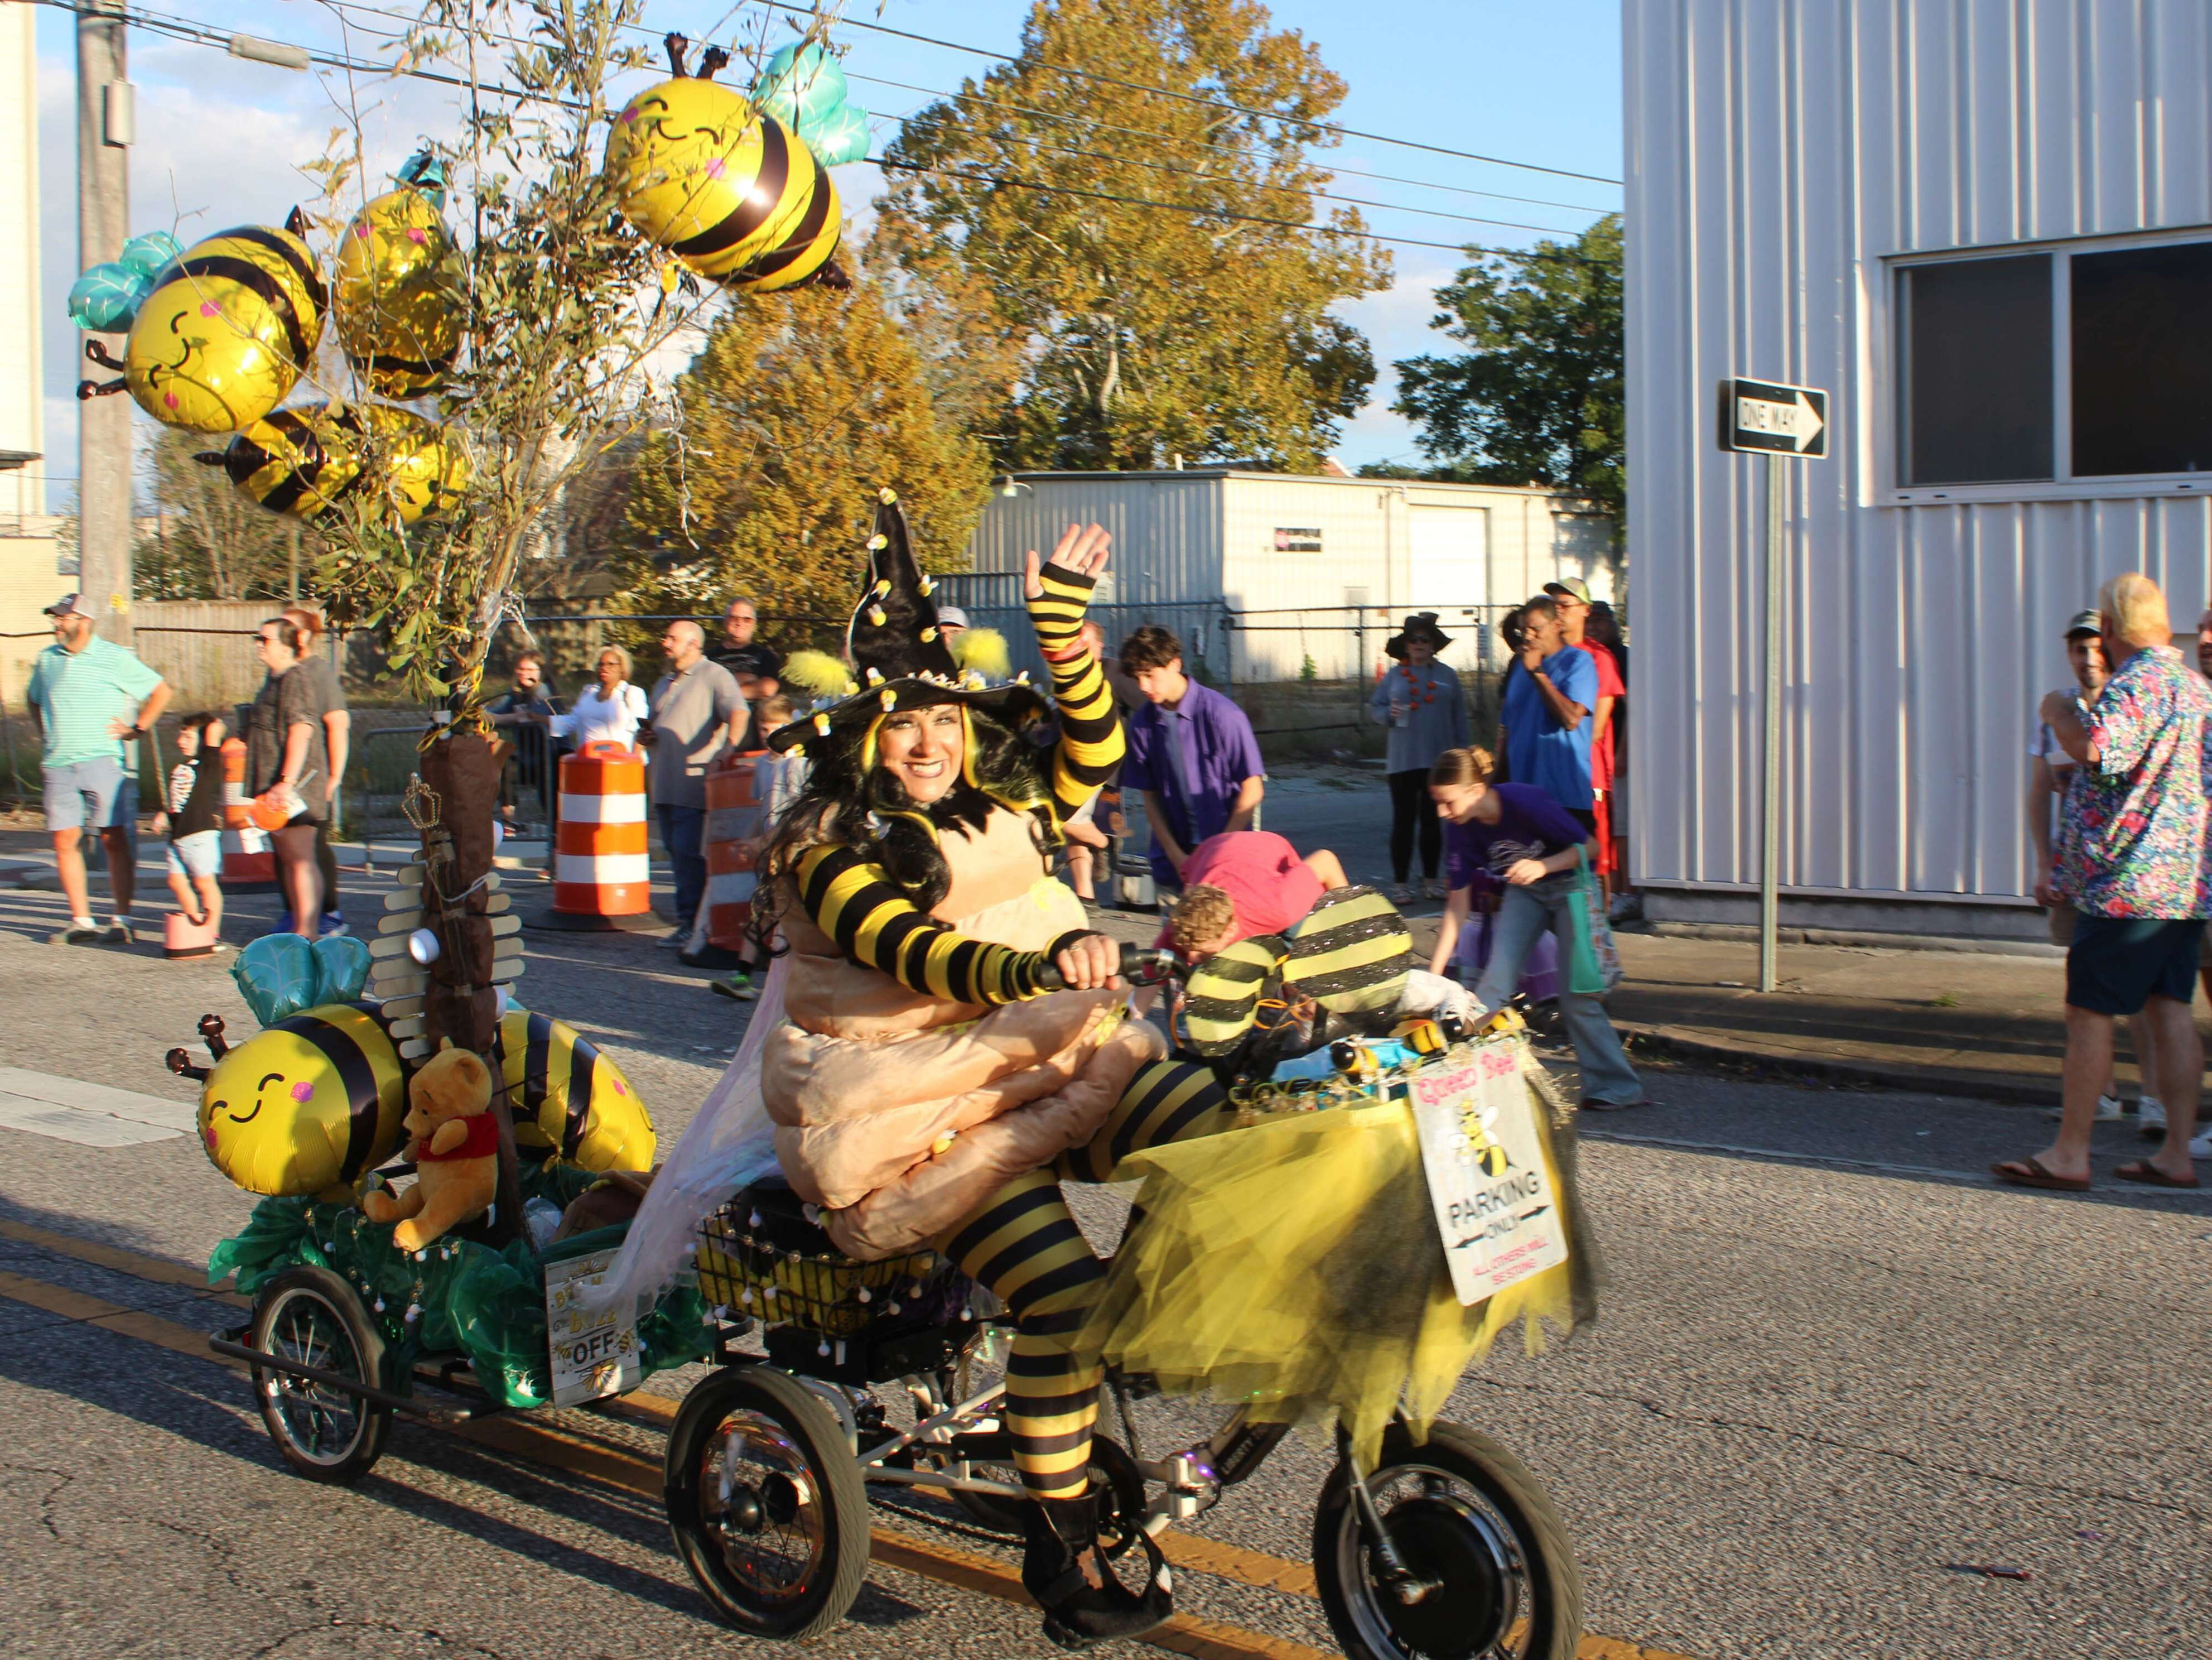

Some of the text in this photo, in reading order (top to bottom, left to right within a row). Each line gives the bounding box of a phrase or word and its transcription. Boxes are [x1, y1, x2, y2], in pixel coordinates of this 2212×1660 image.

[1741, 402, 1797, 433] ONE WAY
[1449, 1171, 1540, 1228] PARKING
[1483, 1213, 1519, 1239] ONLY
[573, 1330, 615, 1365] OFF
